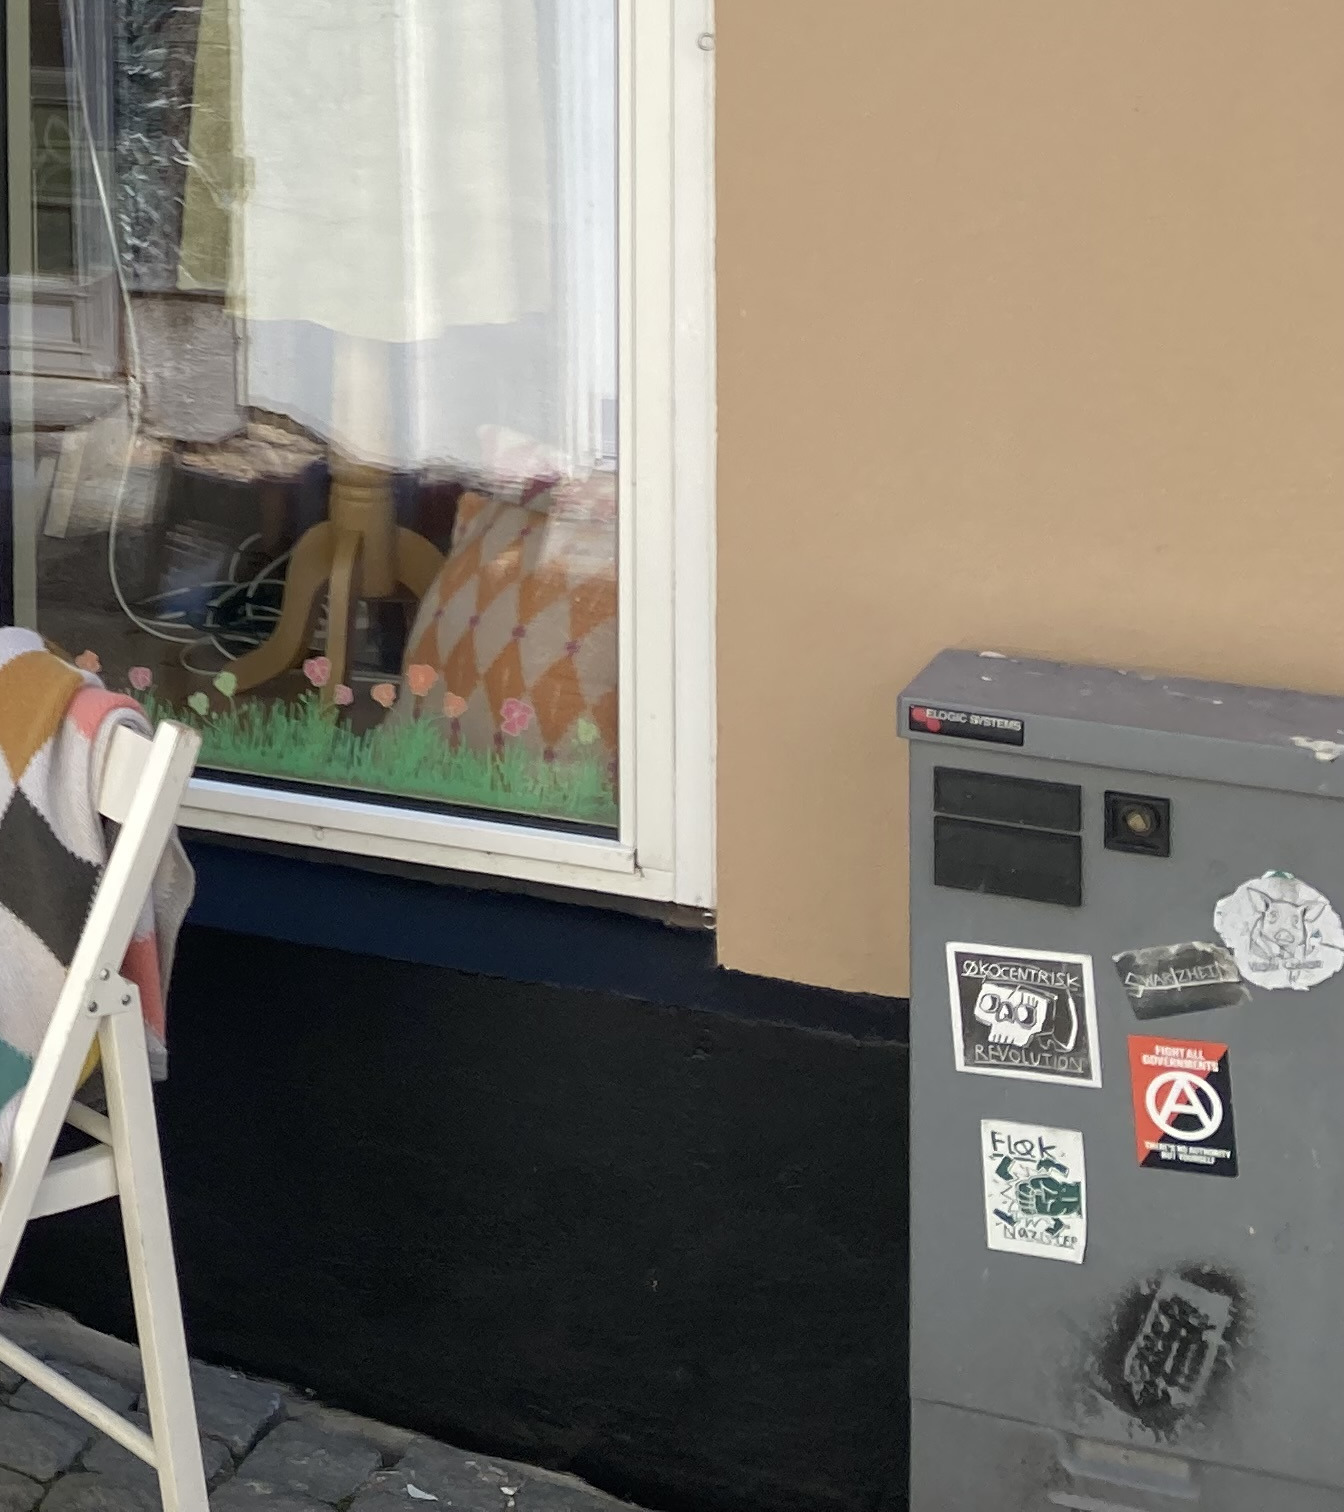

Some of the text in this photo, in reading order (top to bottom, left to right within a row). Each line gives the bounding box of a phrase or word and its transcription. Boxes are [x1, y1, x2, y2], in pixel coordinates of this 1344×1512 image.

[926, 708, 1022, 731] ELOGIC SYSTEMS
[962, 960, 1081, 988] ØKOCENTRISK
[974, 1044, 1083, 1072] REVOLUTION
